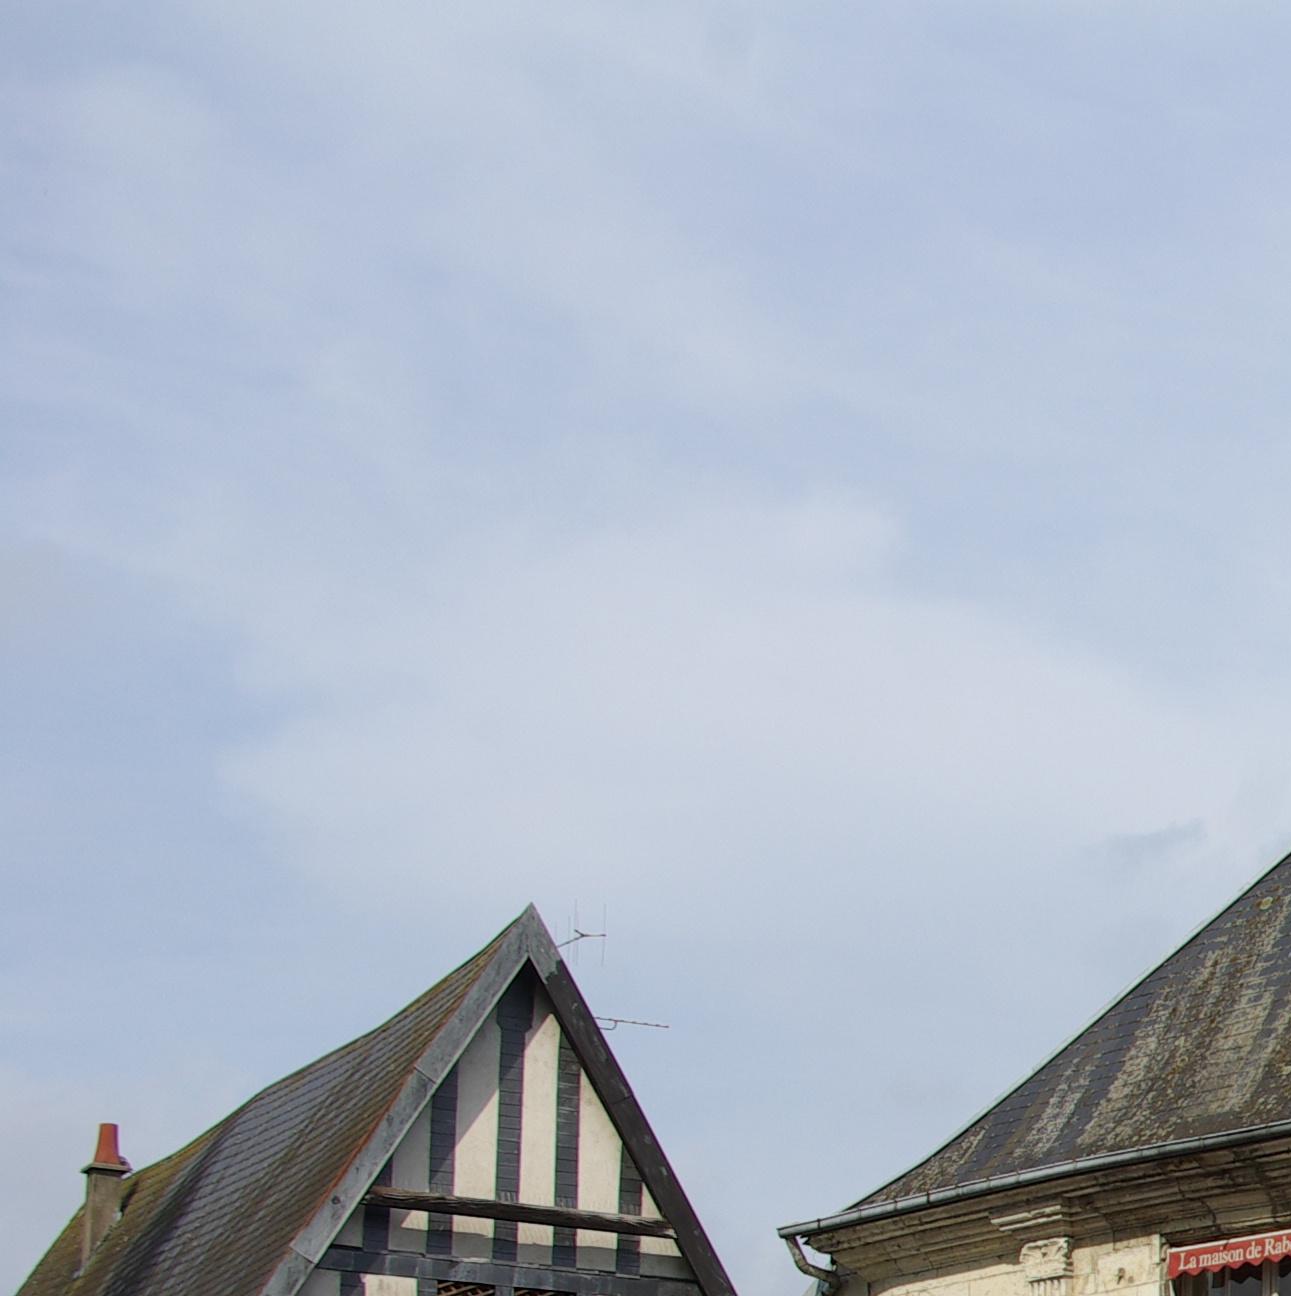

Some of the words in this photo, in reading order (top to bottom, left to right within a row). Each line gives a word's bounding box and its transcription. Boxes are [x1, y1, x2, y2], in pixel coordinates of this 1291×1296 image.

[1178, 1252, 1197, 1270] La
[1199, 1246, 1243, 1267] maison
[1246, 1241, 1261, 1258] de
